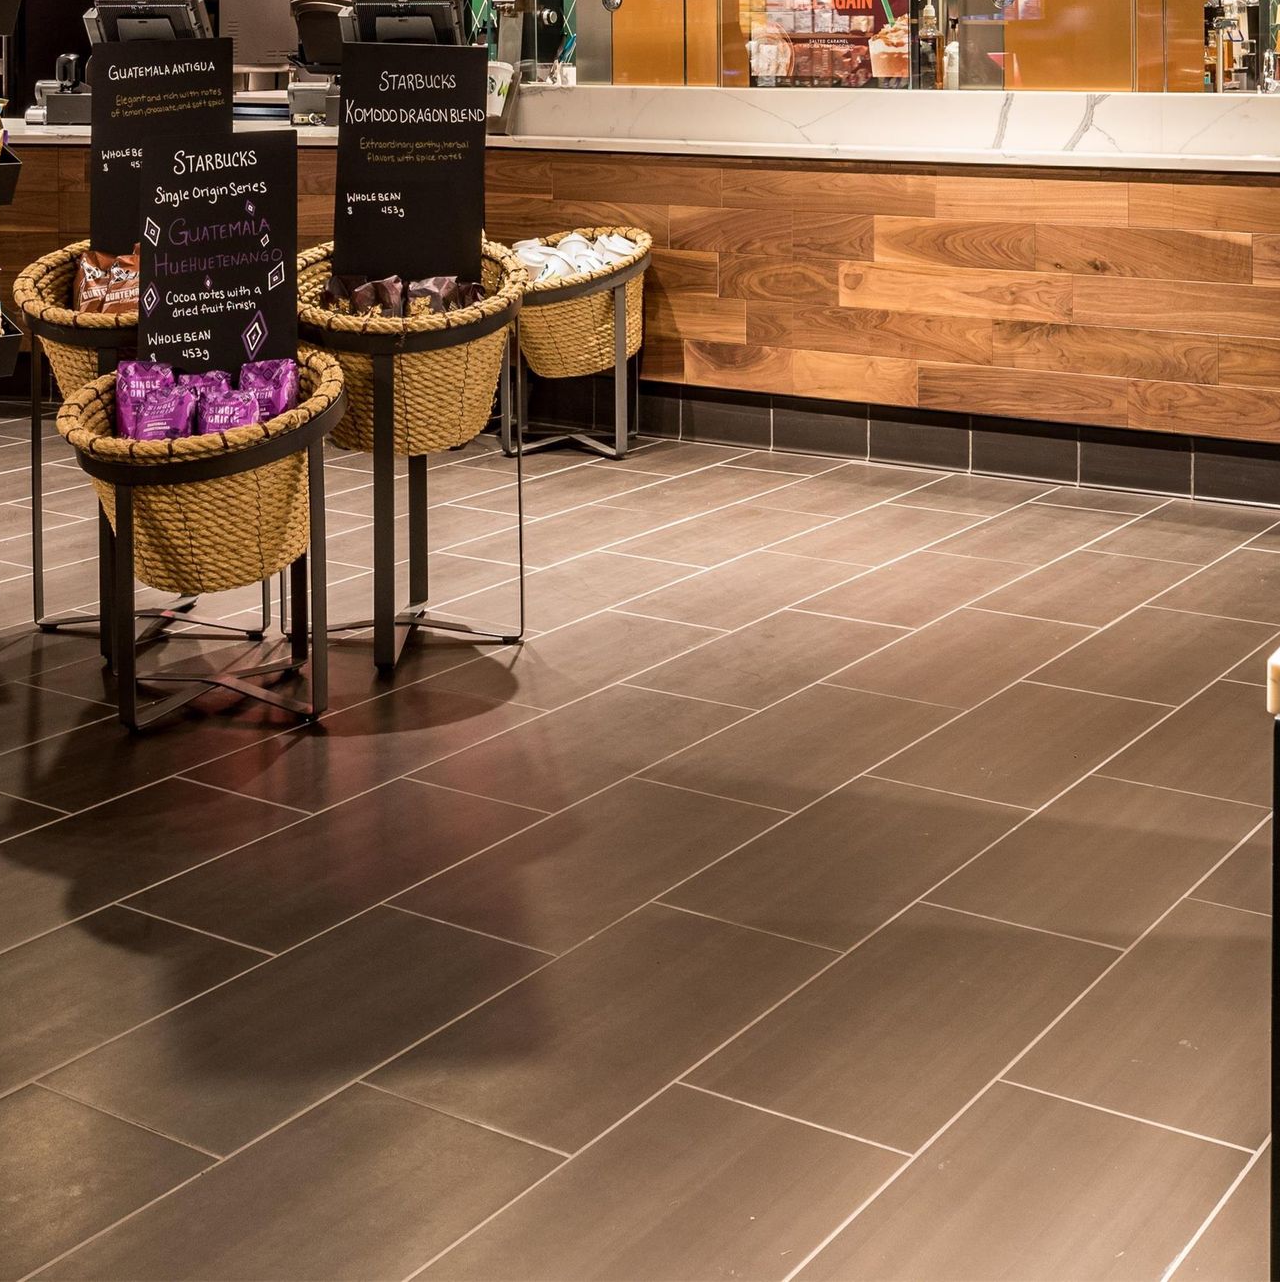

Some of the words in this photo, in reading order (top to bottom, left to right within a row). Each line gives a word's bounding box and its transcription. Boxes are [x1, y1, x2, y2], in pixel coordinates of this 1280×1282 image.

[108, 64, 170, 81] GUATEMALA
[171, 61, 216, 76] ANTIGUA
[378, 70, 457, 92] STARBUCKS
[345, 98, 400, 125] KOMODO
[399, 107, 448, 124] DRAGON
[450, 108, 485, 124] BLEND
[359, 136, 415, 154] Extraordinary
[101, 148, 131, 160] WHOLE
[131, 148, 143, 157] BE
[173, 149, 258, 175] STARBUCKS
[154, 186, 190, 208] Single
[192, 185, 228, 205] Origin
[229, 181, 267, 197] Series
[346, 192, 376, 203] WHOLE
[377, 192, 401, 202] BEAN
[381, 205, 405, 218] 453g
[168, 218, 271, 247] GUATEMALA
[153, 248, 283, 278] HUEHUETENANGO
[82, 287, 108, 300] GUATE
[165, 290, 197, 306] Cocoa
[198, 289, 225, 300] notes
[226, 285, 251, 298] with
[254, 286, 262, 295] a
[172, 304, 199, 318] dried
[200, 303, 224, 316] fruit
[226, 299, 256, 312] finish
[147, 331, 182, 346] WHOLE
[183, 329, 211, 343] BEAN
[182, 348, 210, 361] 453g
[130, 380, 160, 389] SINGLE
[130, 389, 145, 398] ORI
[208, 414, 240, 424] ORIGIN
[209, 406, 240, 415] SINGLE
